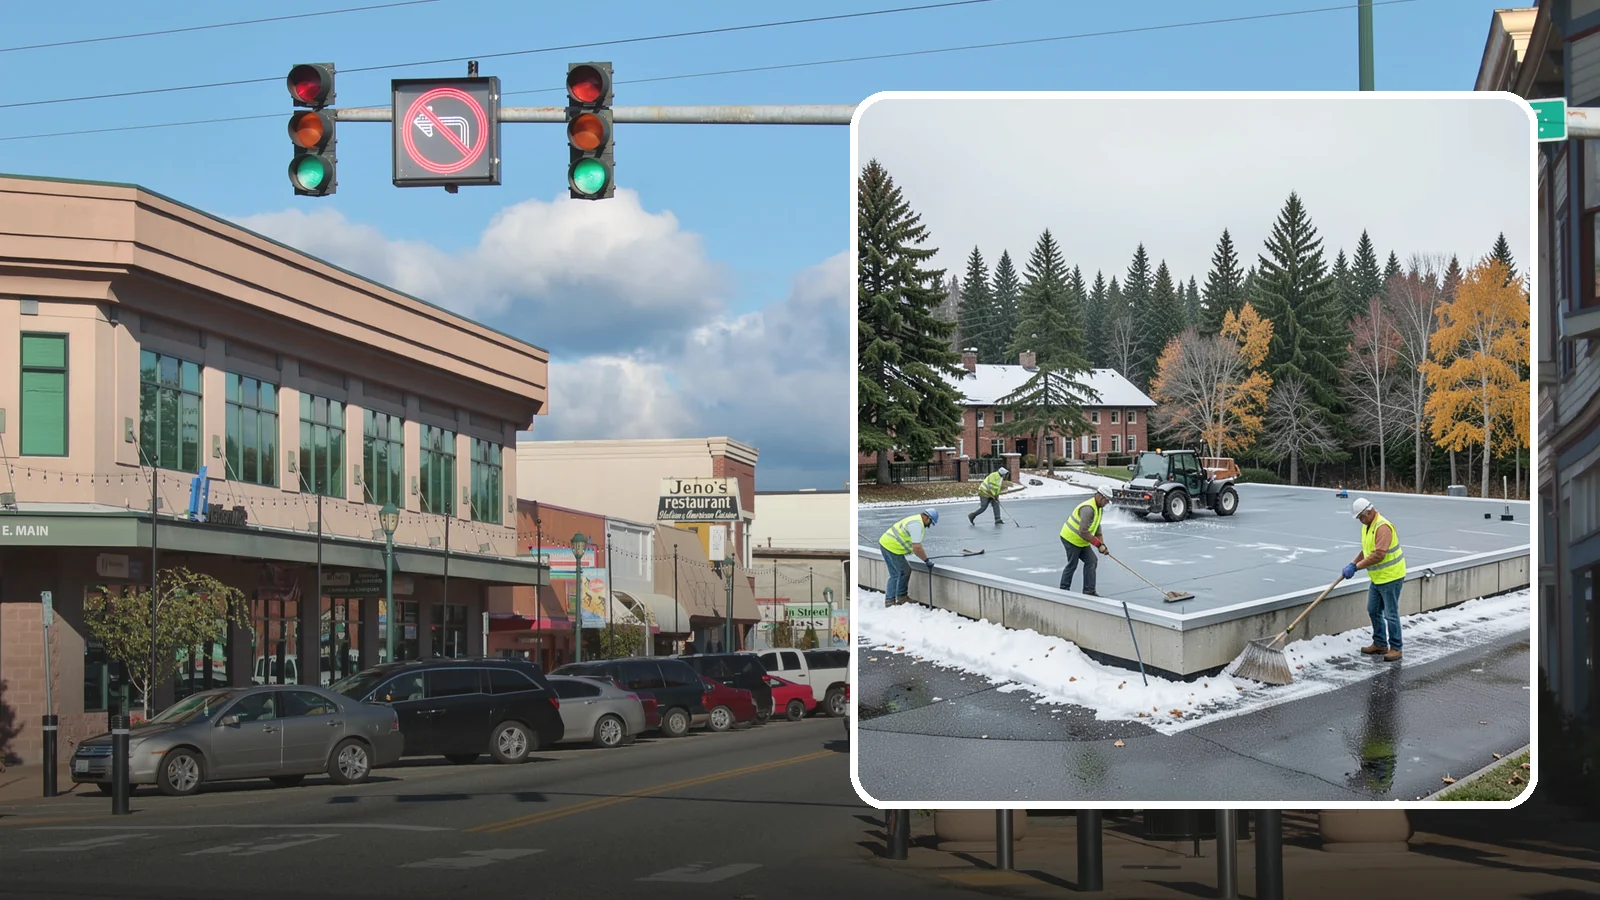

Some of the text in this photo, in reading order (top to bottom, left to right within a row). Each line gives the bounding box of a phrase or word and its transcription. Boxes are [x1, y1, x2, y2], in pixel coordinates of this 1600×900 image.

[670, 480, 727, 494] Jeno's
[665, 496, 731, 509] restaurant
[659, 510, 681, 519] Italian
[686, 510, 714, 519] American
[714, 510, 737, 519] Cuisine
[2, 525, 49, 536] E. MAIN
[797, 607, 829, 617] Street
